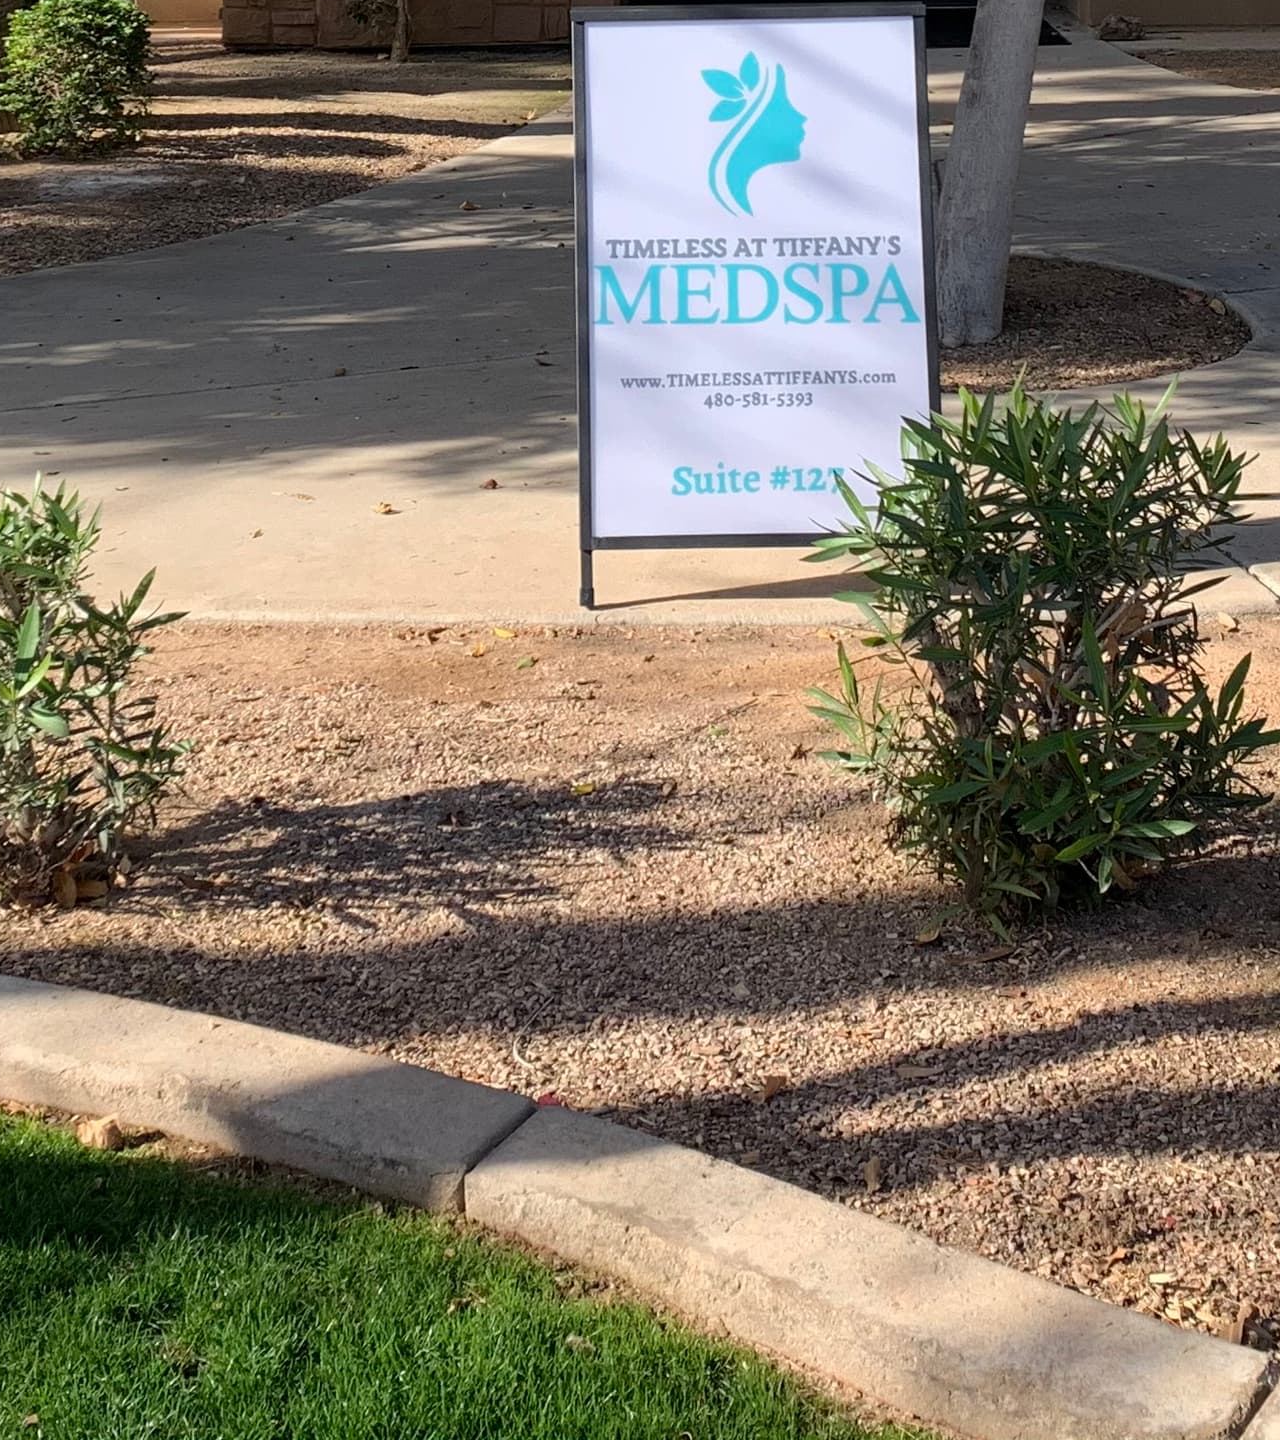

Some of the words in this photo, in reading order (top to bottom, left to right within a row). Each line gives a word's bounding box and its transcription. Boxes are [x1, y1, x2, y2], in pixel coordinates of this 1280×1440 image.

[606, 237, 727, 259] TIMELESS
[733, 237, 767, 258] AT
[773, 235, 901, 258] TIFFANY'S
[593, 262, 921, 325] MEDSPA
[620, 370, 897, 389] www.TIMELESSATTIFFANYS.com
[704, 391, 813, 409] 480-581-5393
[671, 461, 760, 496] Suite
[771, 465, 845, 494] #127
